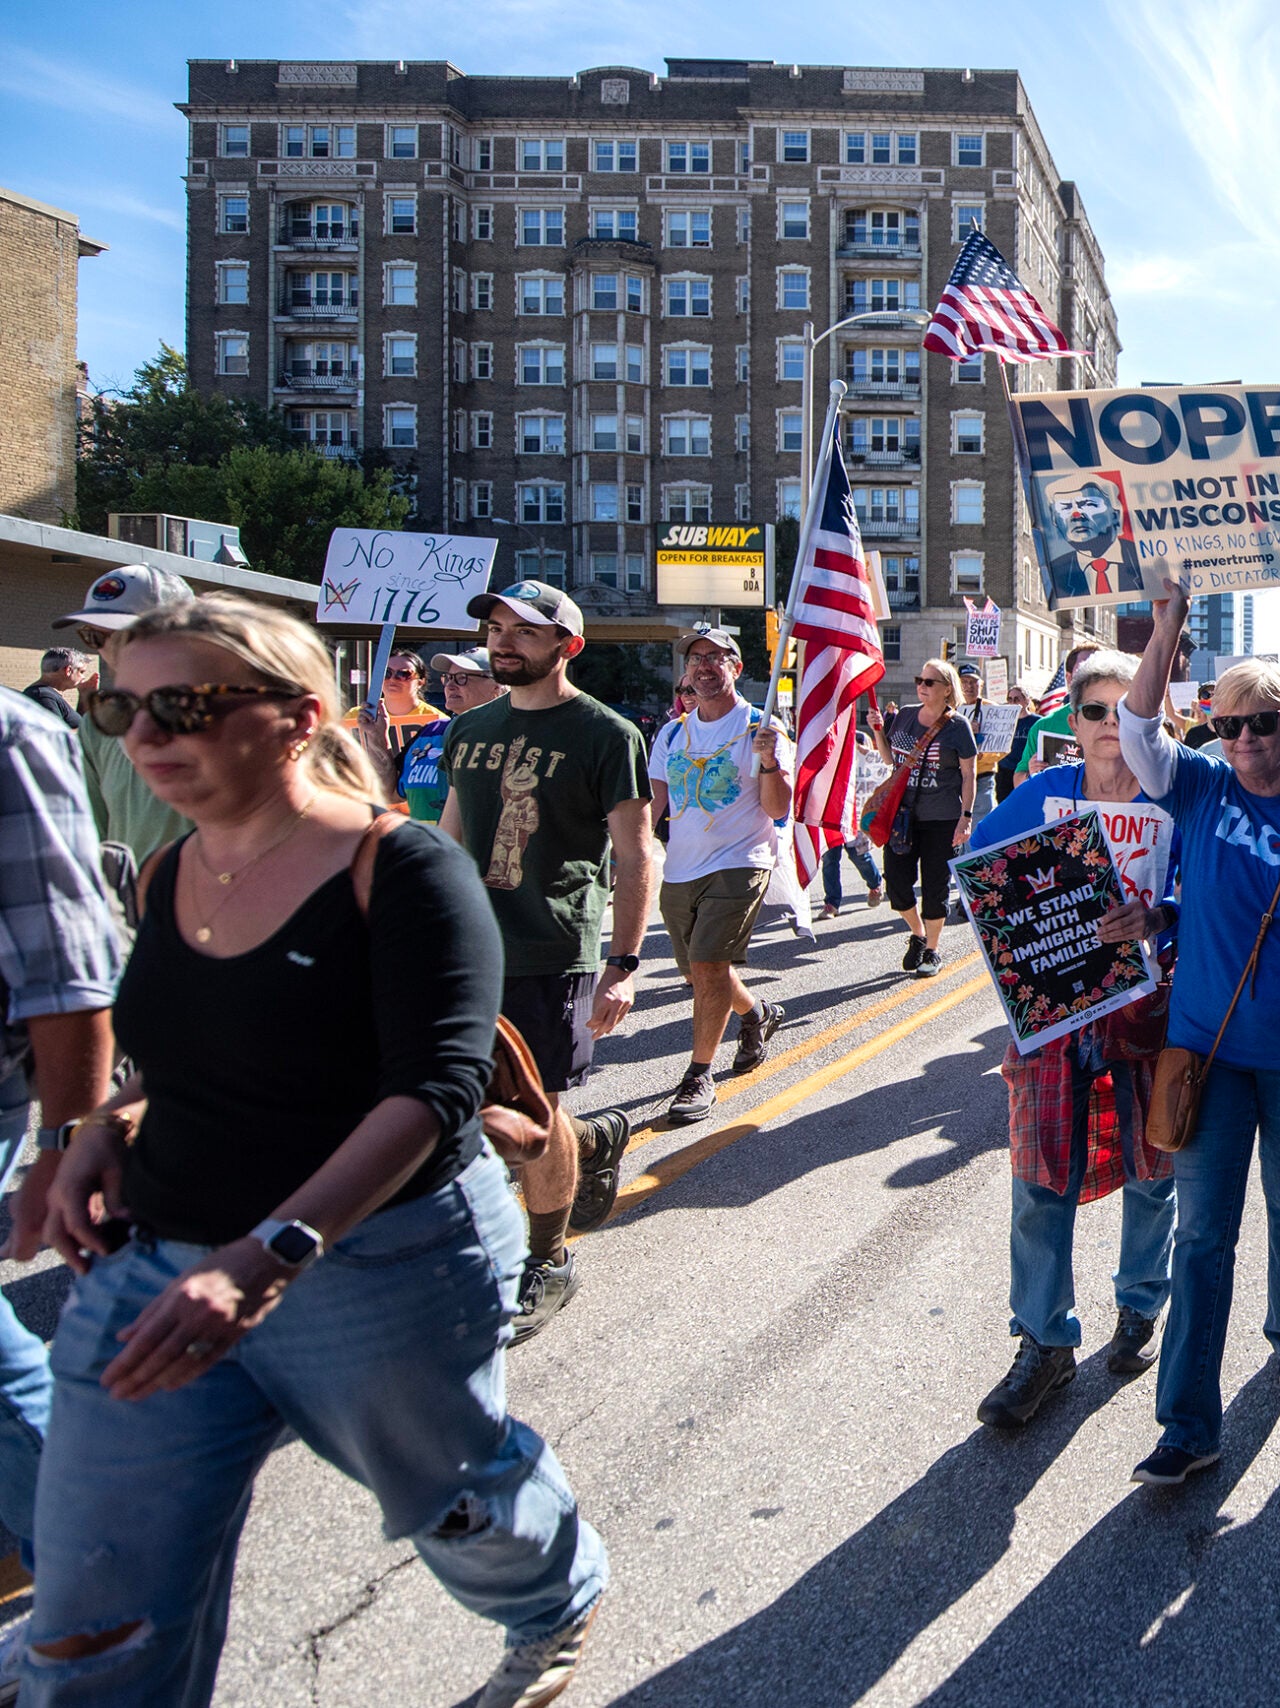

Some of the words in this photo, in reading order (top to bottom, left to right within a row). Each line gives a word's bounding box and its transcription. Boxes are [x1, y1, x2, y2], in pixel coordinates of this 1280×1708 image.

[1172, 476, 1238, 501] NOT
[1247, 473, 1280, 496] IN
[661, 525, 760, 547] SUBWAY
[1139, 539, 1168, 558] NO
[1174, 535, 1224, 552] KINGS,
[1227, 533, 1246, 549] NO
[343, 532, 394, 568] No
[417, 537, 486, 590] Kings
[659, 553, 687, 562] OPEN
[689, 554, 708, 562] FOR
[711, 554, 763, 563] BREAKFAST
[1182, 552, 1275, 570] #nevertrump
[386, 572, 437, 591] since
[1178, 573, 1203, 590] NO
[370, 586, 441, 623] 1776
[970, 624, 999, 636] SHUT
[970, 634, 997, 644] DOWN
[985, 708, 1017, 720] RACISM
[984, 721, 1015, 732] FASCISM
[453, 736, 567, 779] RESIST
[1055, 752, 1065, 760] NO
[1006, 906, 1036, 927] WE
[1038, 883, 1096, 915] STAND
[1033, 911, 1080, 935] WITH
[1030, 936, 1103, 975] FAMILIES
